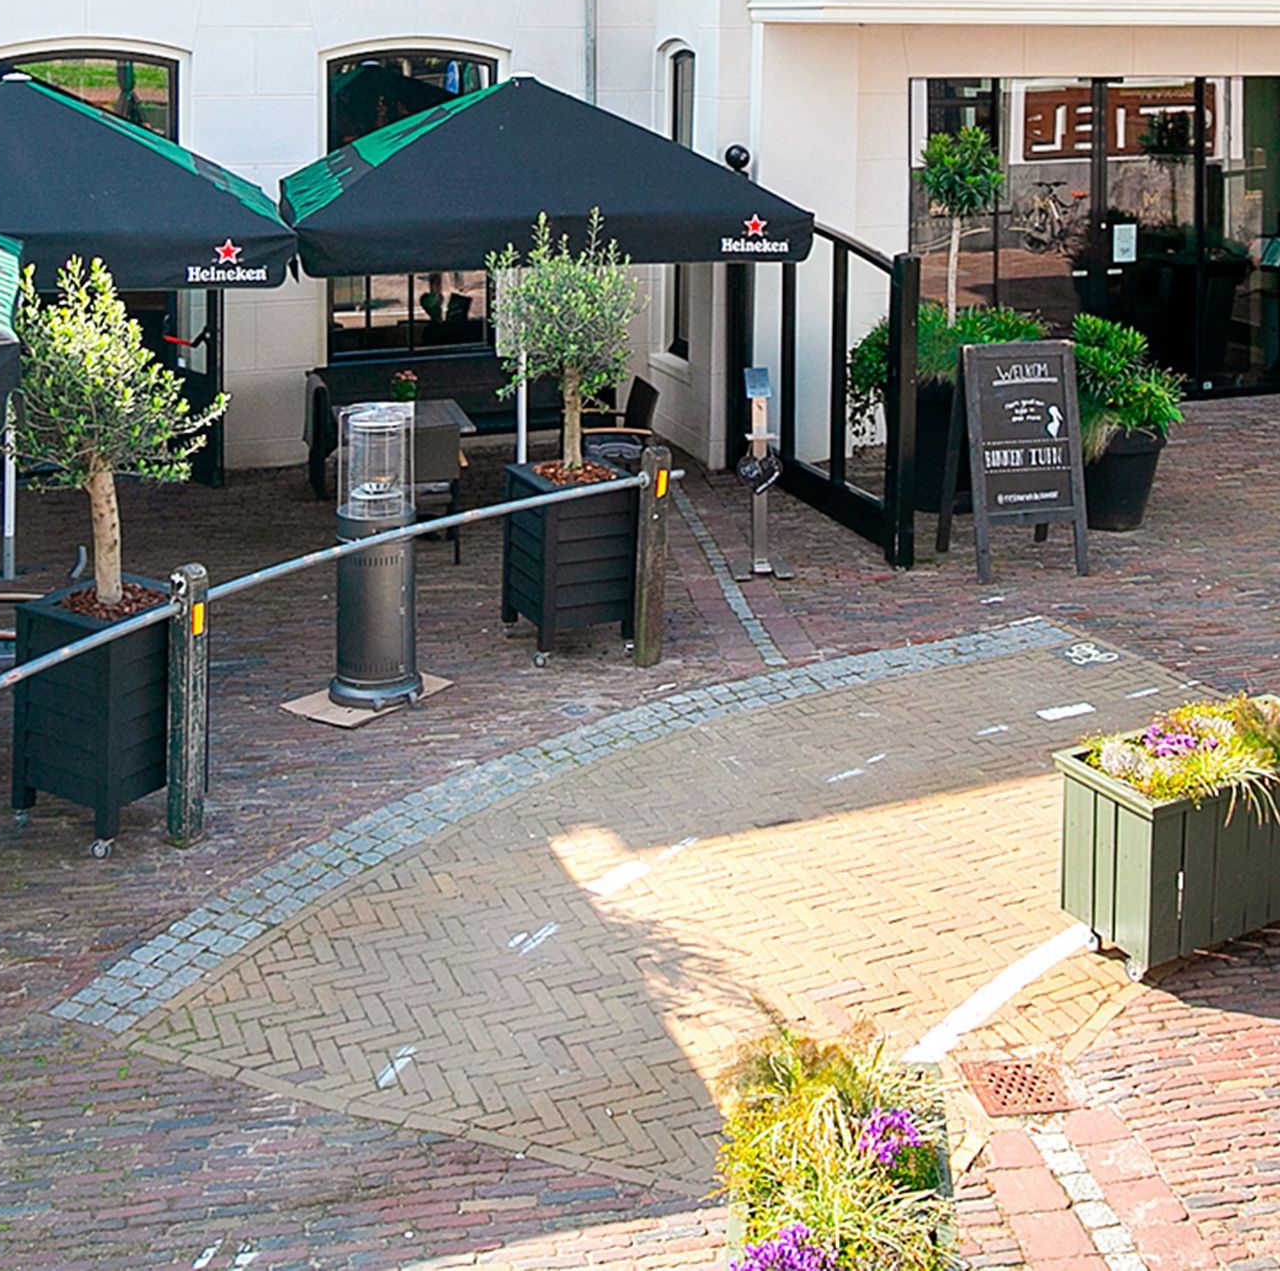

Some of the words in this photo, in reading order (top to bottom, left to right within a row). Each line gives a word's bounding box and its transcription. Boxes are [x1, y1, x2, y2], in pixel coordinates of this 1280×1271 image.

[721, 237, 789, 252] Heineken
[187, 265, 267, 282] Heineken
[995, 363, 1048, 380] WELKOM
